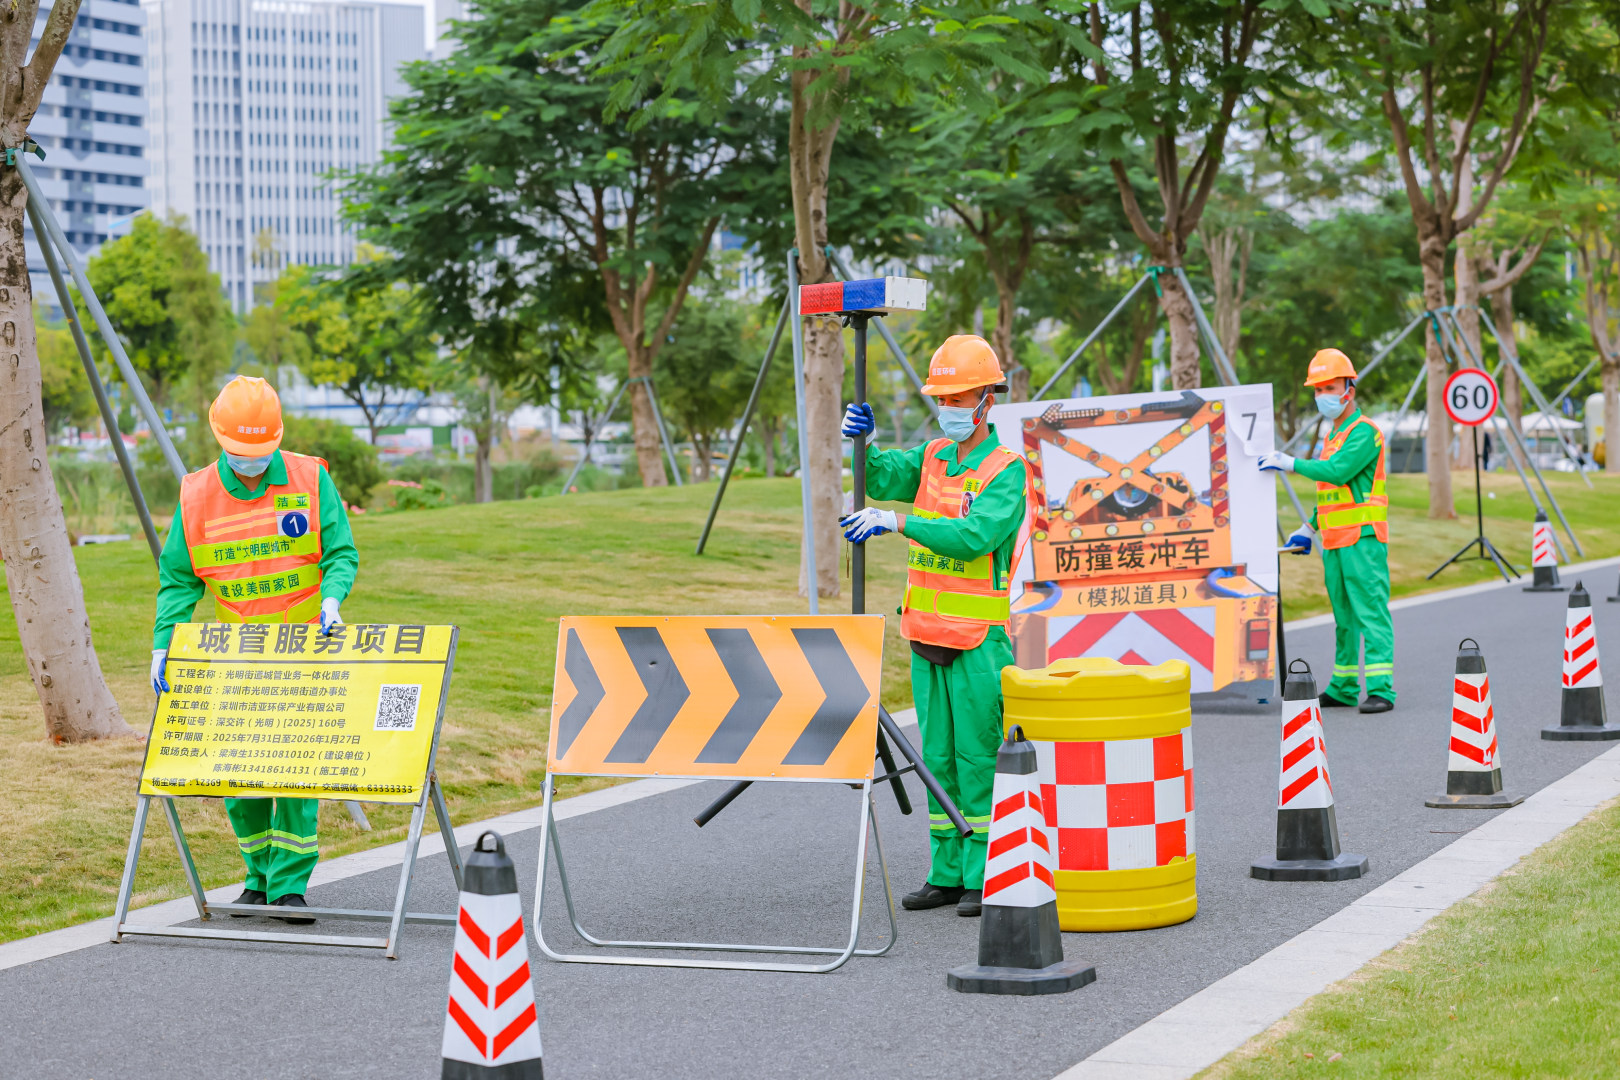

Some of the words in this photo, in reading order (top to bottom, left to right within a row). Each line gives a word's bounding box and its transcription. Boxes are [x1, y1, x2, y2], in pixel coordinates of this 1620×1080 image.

[1452, 385, 1489, 410] 60
[1241, 412, 1257, 441] 7
[289, 515, 300, 535] 1
[1055, 537, 1210, 573] 防撞缓冲车
[219, 573, 300, 598] 建设美丽家园
[1077, 583, 1188, 608] （模拟道具）
[198, 623, 426, 654] 城管服务项目
